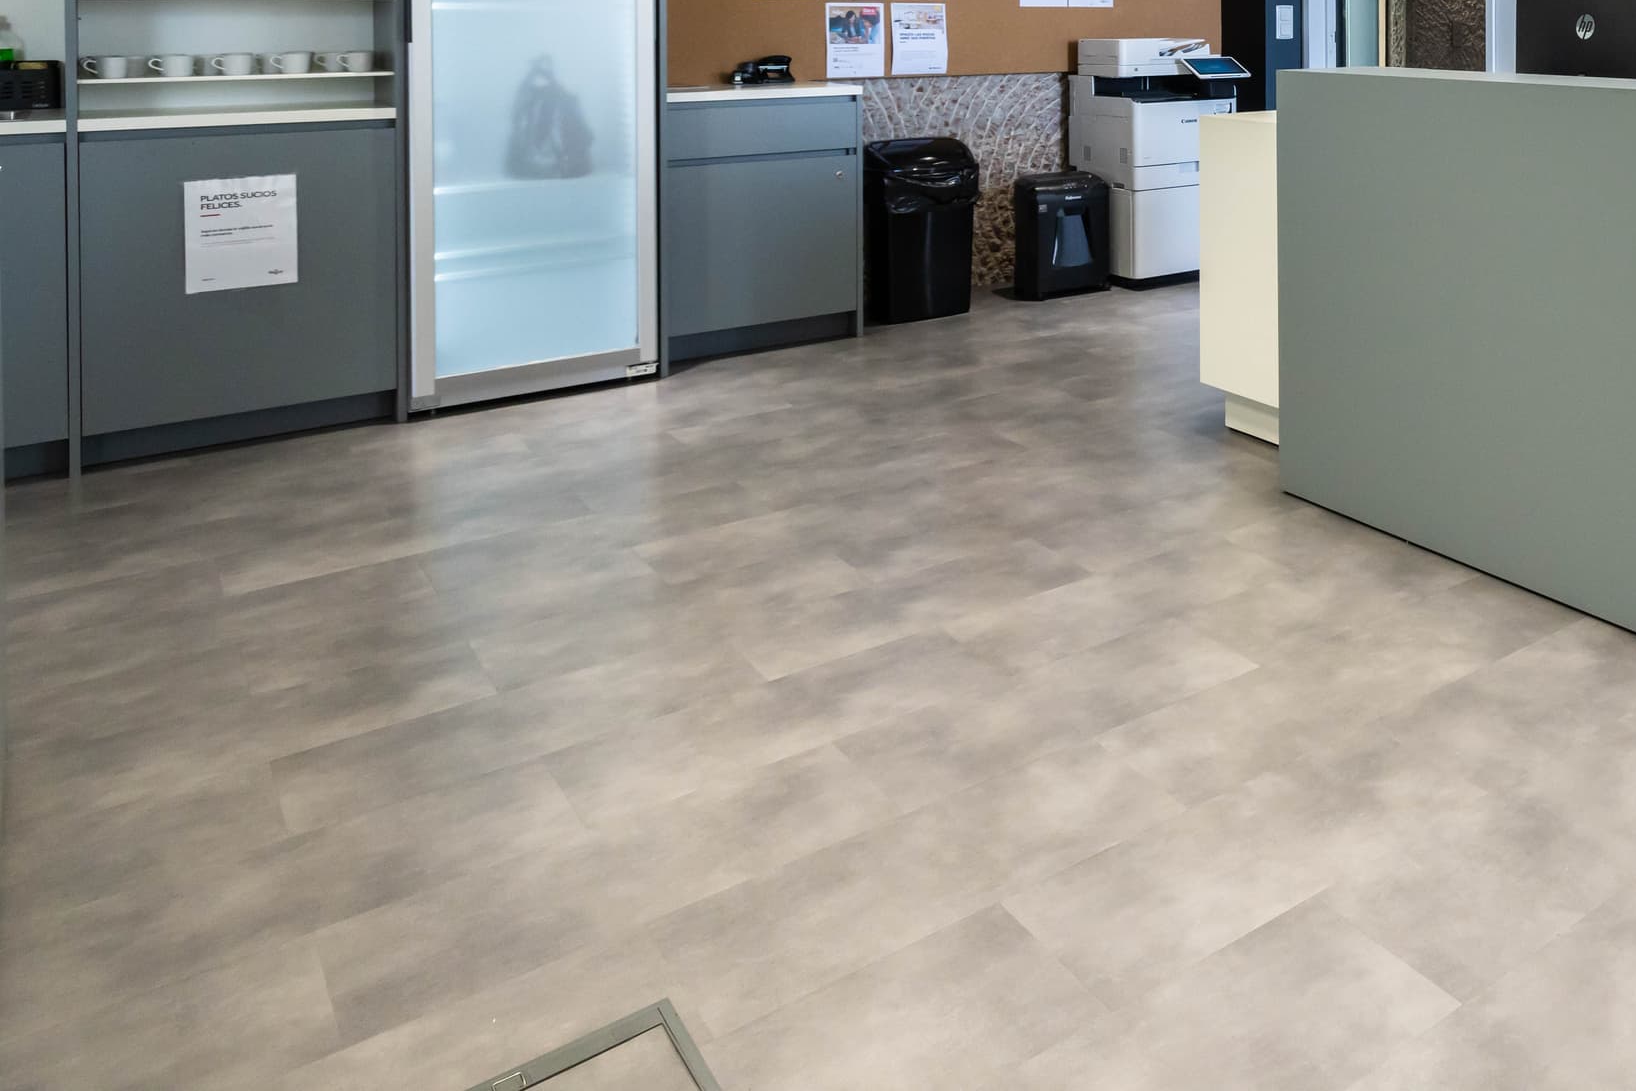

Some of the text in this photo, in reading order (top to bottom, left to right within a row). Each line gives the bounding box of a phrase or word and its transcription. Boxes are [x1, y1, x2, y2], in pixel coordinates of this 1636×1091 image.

[1577, 14, 1594, 39] hp
[200, 190, 277, 202] PLATOS SUCIOS
[200, 201, 242, 210] FELICES.
